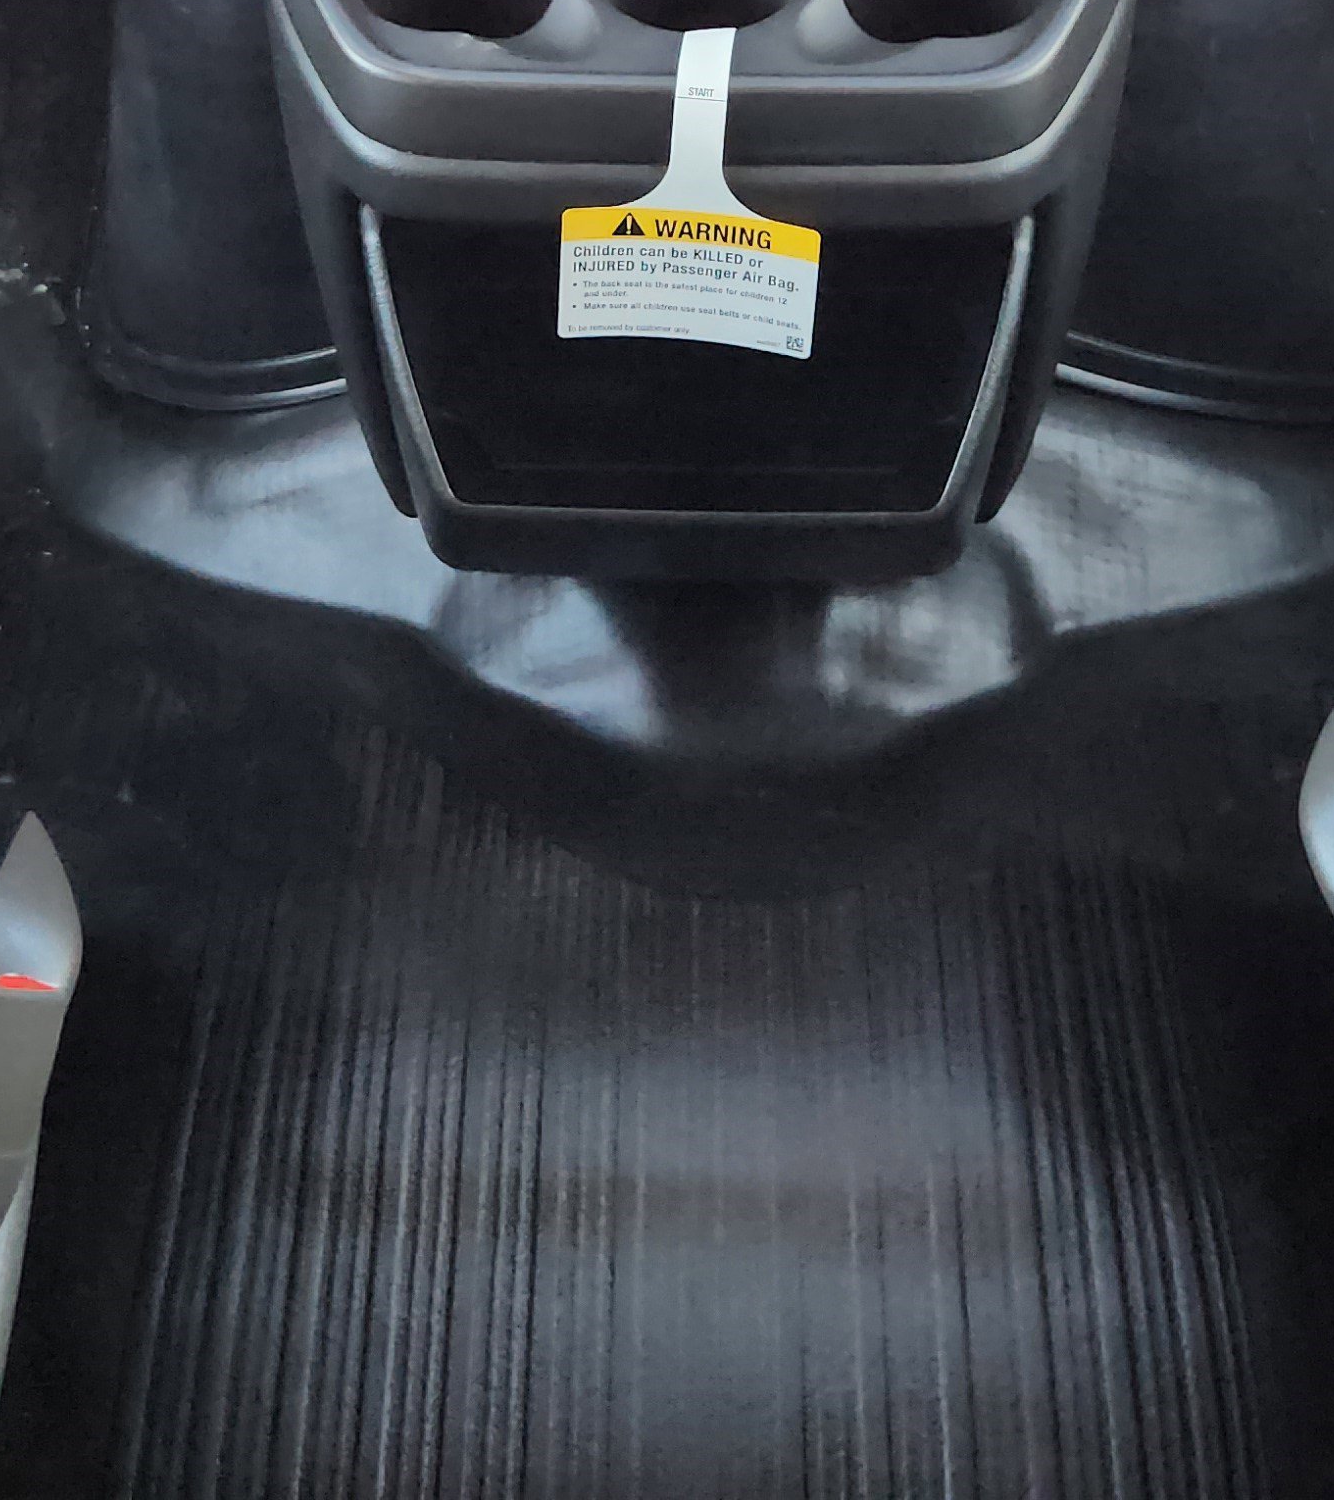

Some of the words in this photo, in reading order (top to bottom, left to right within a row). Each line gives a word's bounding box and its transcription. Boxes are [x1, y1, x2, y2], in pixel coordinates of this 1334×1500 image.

[688, 86, 714, 97] START
[655, 218, 771, 250] WARNING
[573, 245, 634, 257] Children
[639, 247, 665, 257] can
[671, 247, 688, 259] be
[693, 249, 743, 265] KILLED
[749, 258, 764, 268] or
[573, 260, 635, 273] INJURED
[641, 261, 657, 274] by
[662, 262, 738, 279] Passenger
[742, 271, 763, 284] Air
[768, 275, 799, 292] Bag.
[655, 281, 668, 289] the
[671, 282, 698, 291] safest
[700, 285, 723, 294] place
[726, 287, 738, 295] for
[740, 290, 774, 302] children
[778, 297, 788, 305] 12
[584, 302, 606, 310] Make
[680, 305, 696, 313] use
[719, 309, 739, 319] belts
[753, 314, 774, 324] child
